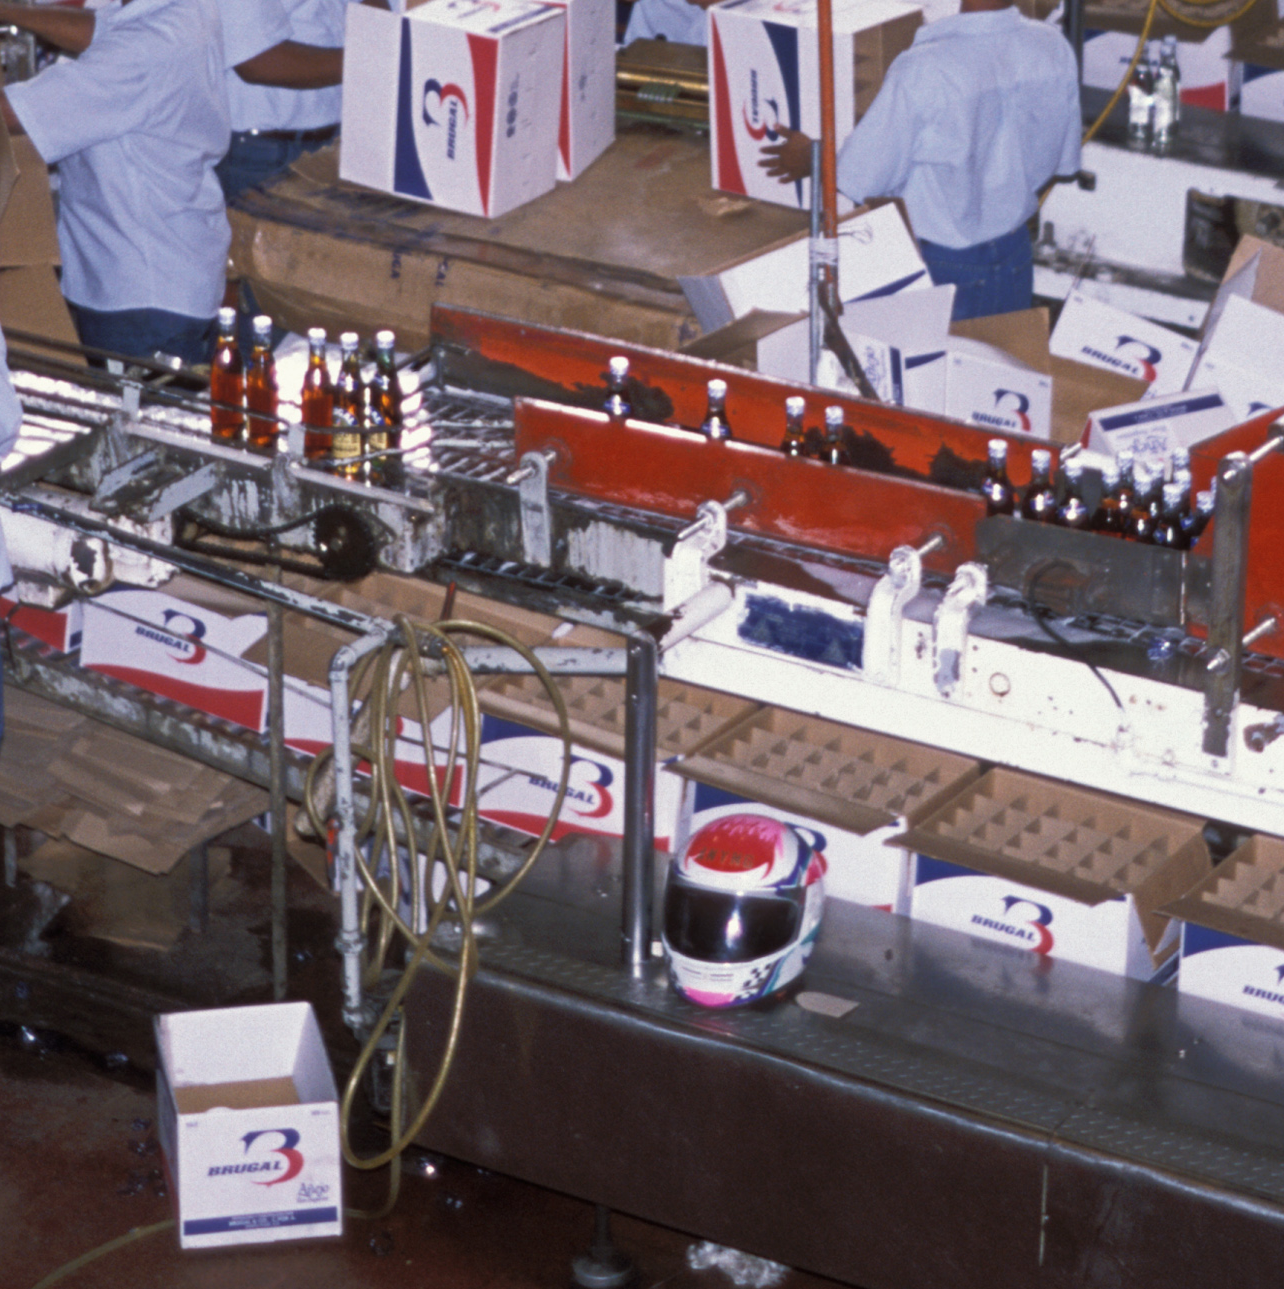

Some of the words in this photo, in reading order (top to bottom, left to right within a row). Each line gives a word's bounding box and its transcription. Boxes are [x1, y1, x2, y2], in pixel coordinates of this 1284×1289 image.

[446, 100, 458, 161] BRUGAL
[1081, 345, 1140, 375] BRUGAL
[972, 411, 1017, 429] BRUGAL
[134, 625, 191, 654] BRUGAL
[971, 914, 1036, 943] BRUGAL
[207, 1161, 282, 1177] BRUGAL
